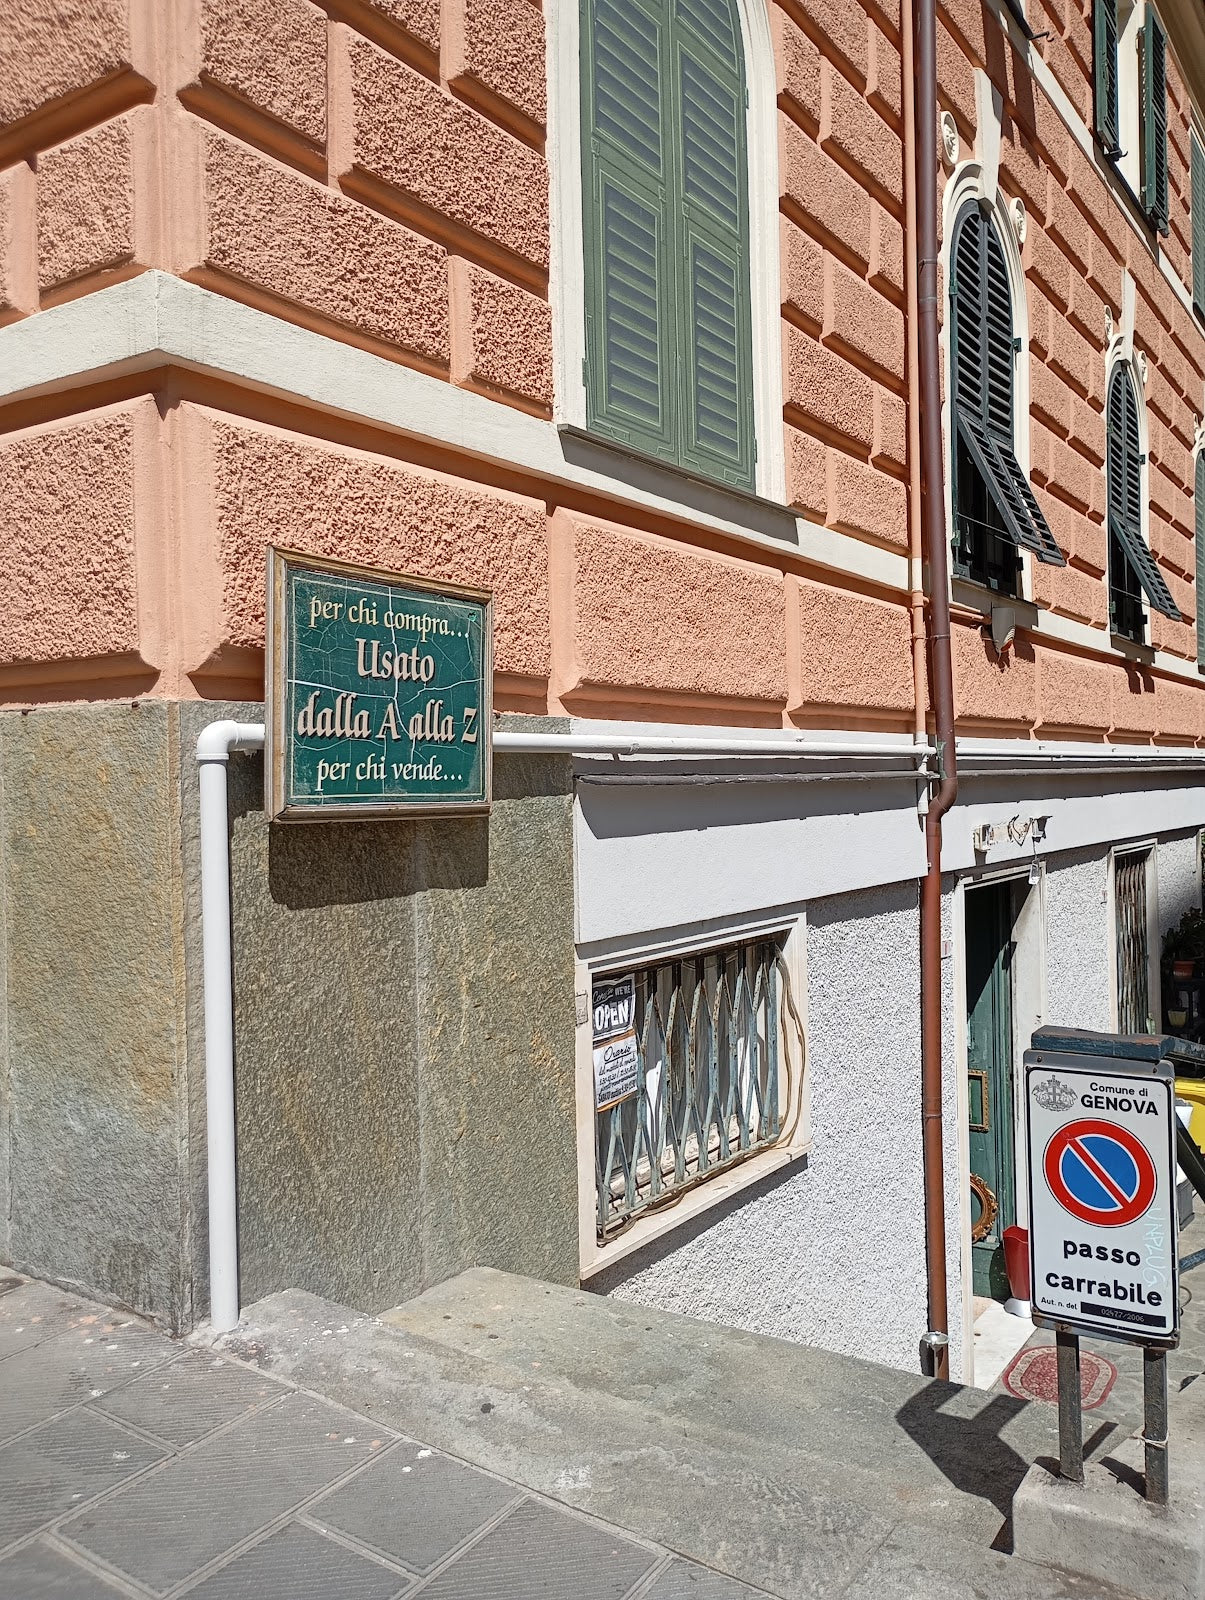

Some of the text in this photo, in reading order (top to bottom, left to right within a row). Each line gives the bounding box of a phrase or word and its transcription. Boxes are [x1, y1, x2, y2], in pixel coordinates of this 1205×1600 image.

[310, 595, 470, 643] per chi compra...
[355, 638, 435, 682] Usato
[297, 691, 478, 743] dalla A alla Z
[315, 753, 462, 791] per chi vende...
[594, 999, 629, 1031] OPEN
[1081, 1094, 1159, 1116] GENOVA
[1089, 1082, 1148, 1097] Comune di
[1063, 1239, 1141, 1267] passo
[1041, 1296, 1056, 1306] Aut.
[1066, 1302, 1078, 1310] del
[1045, 1270, 1163, 1307] carrabile
